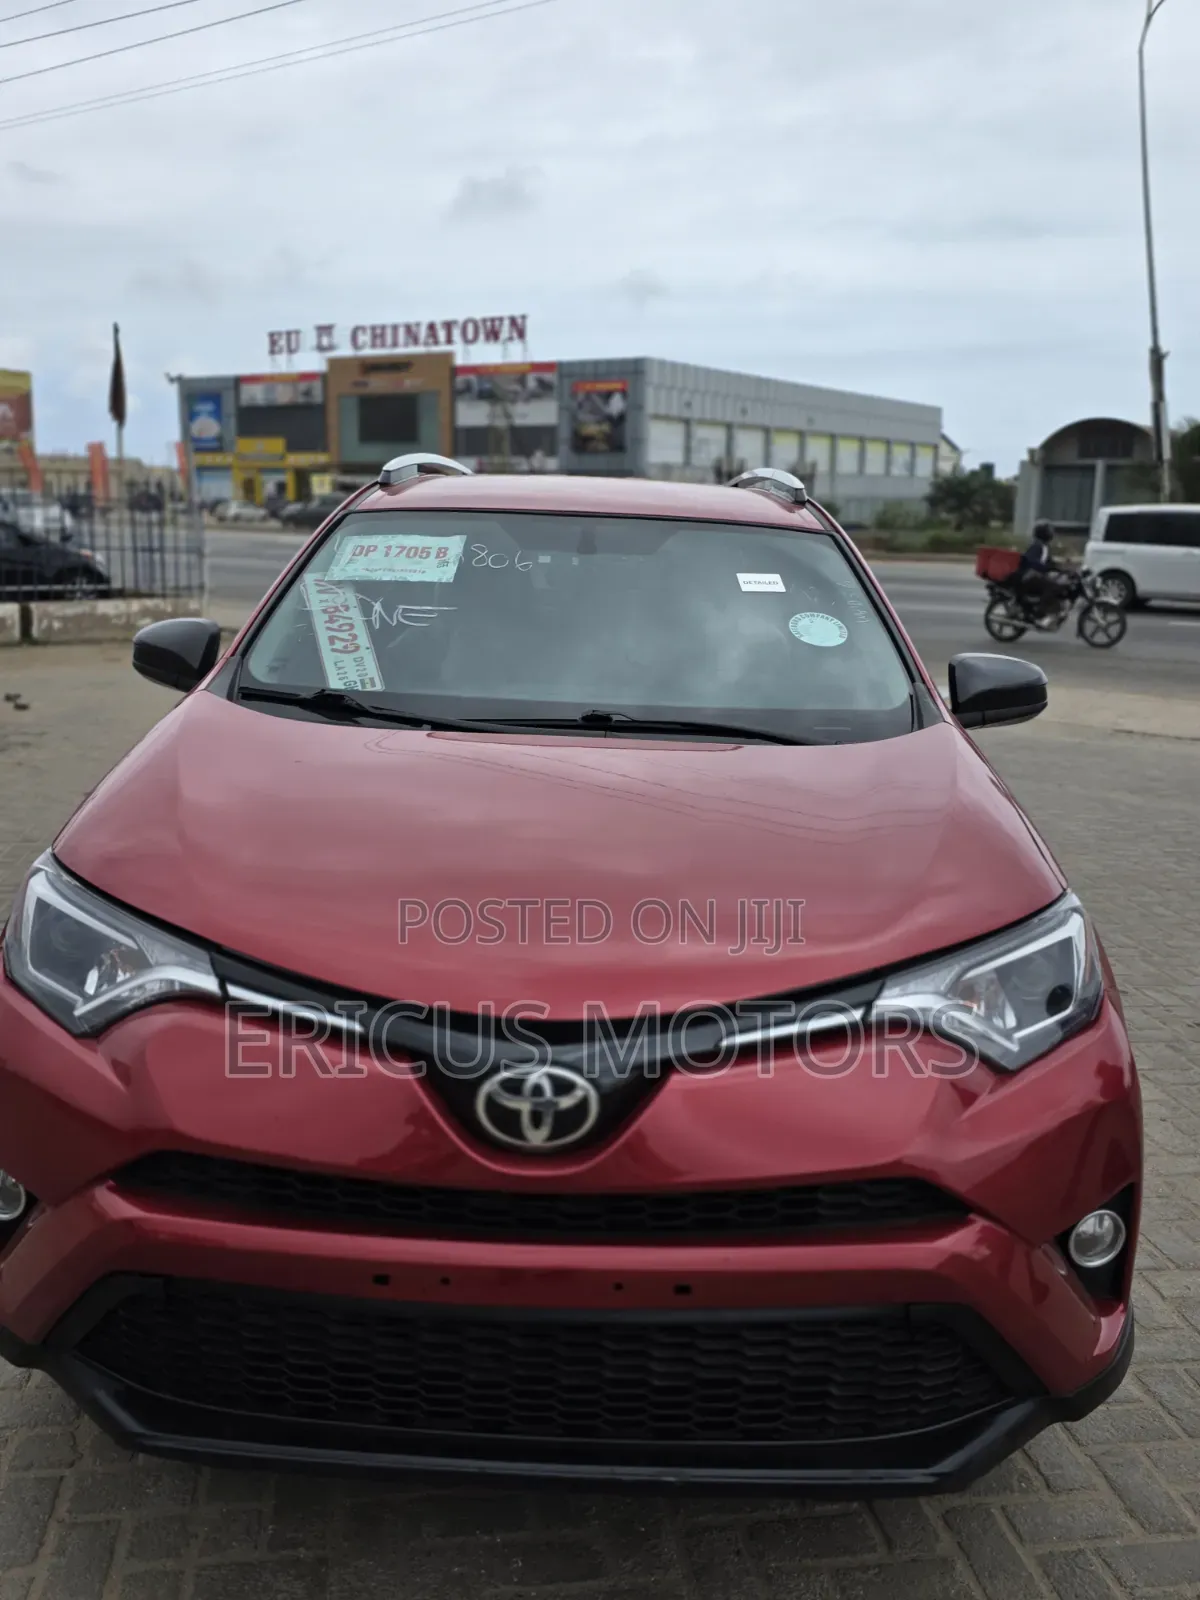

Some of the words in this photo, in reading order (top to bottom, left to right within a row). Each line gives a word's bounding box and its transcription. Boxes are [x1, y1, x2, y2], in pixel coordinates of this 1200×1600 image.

[267, 328, 302, 356] EU
[350, 313, 528, 351] CHINATOWN
[383, 544, 433, 560] 1705
[470, 543, 533, 572] 806
